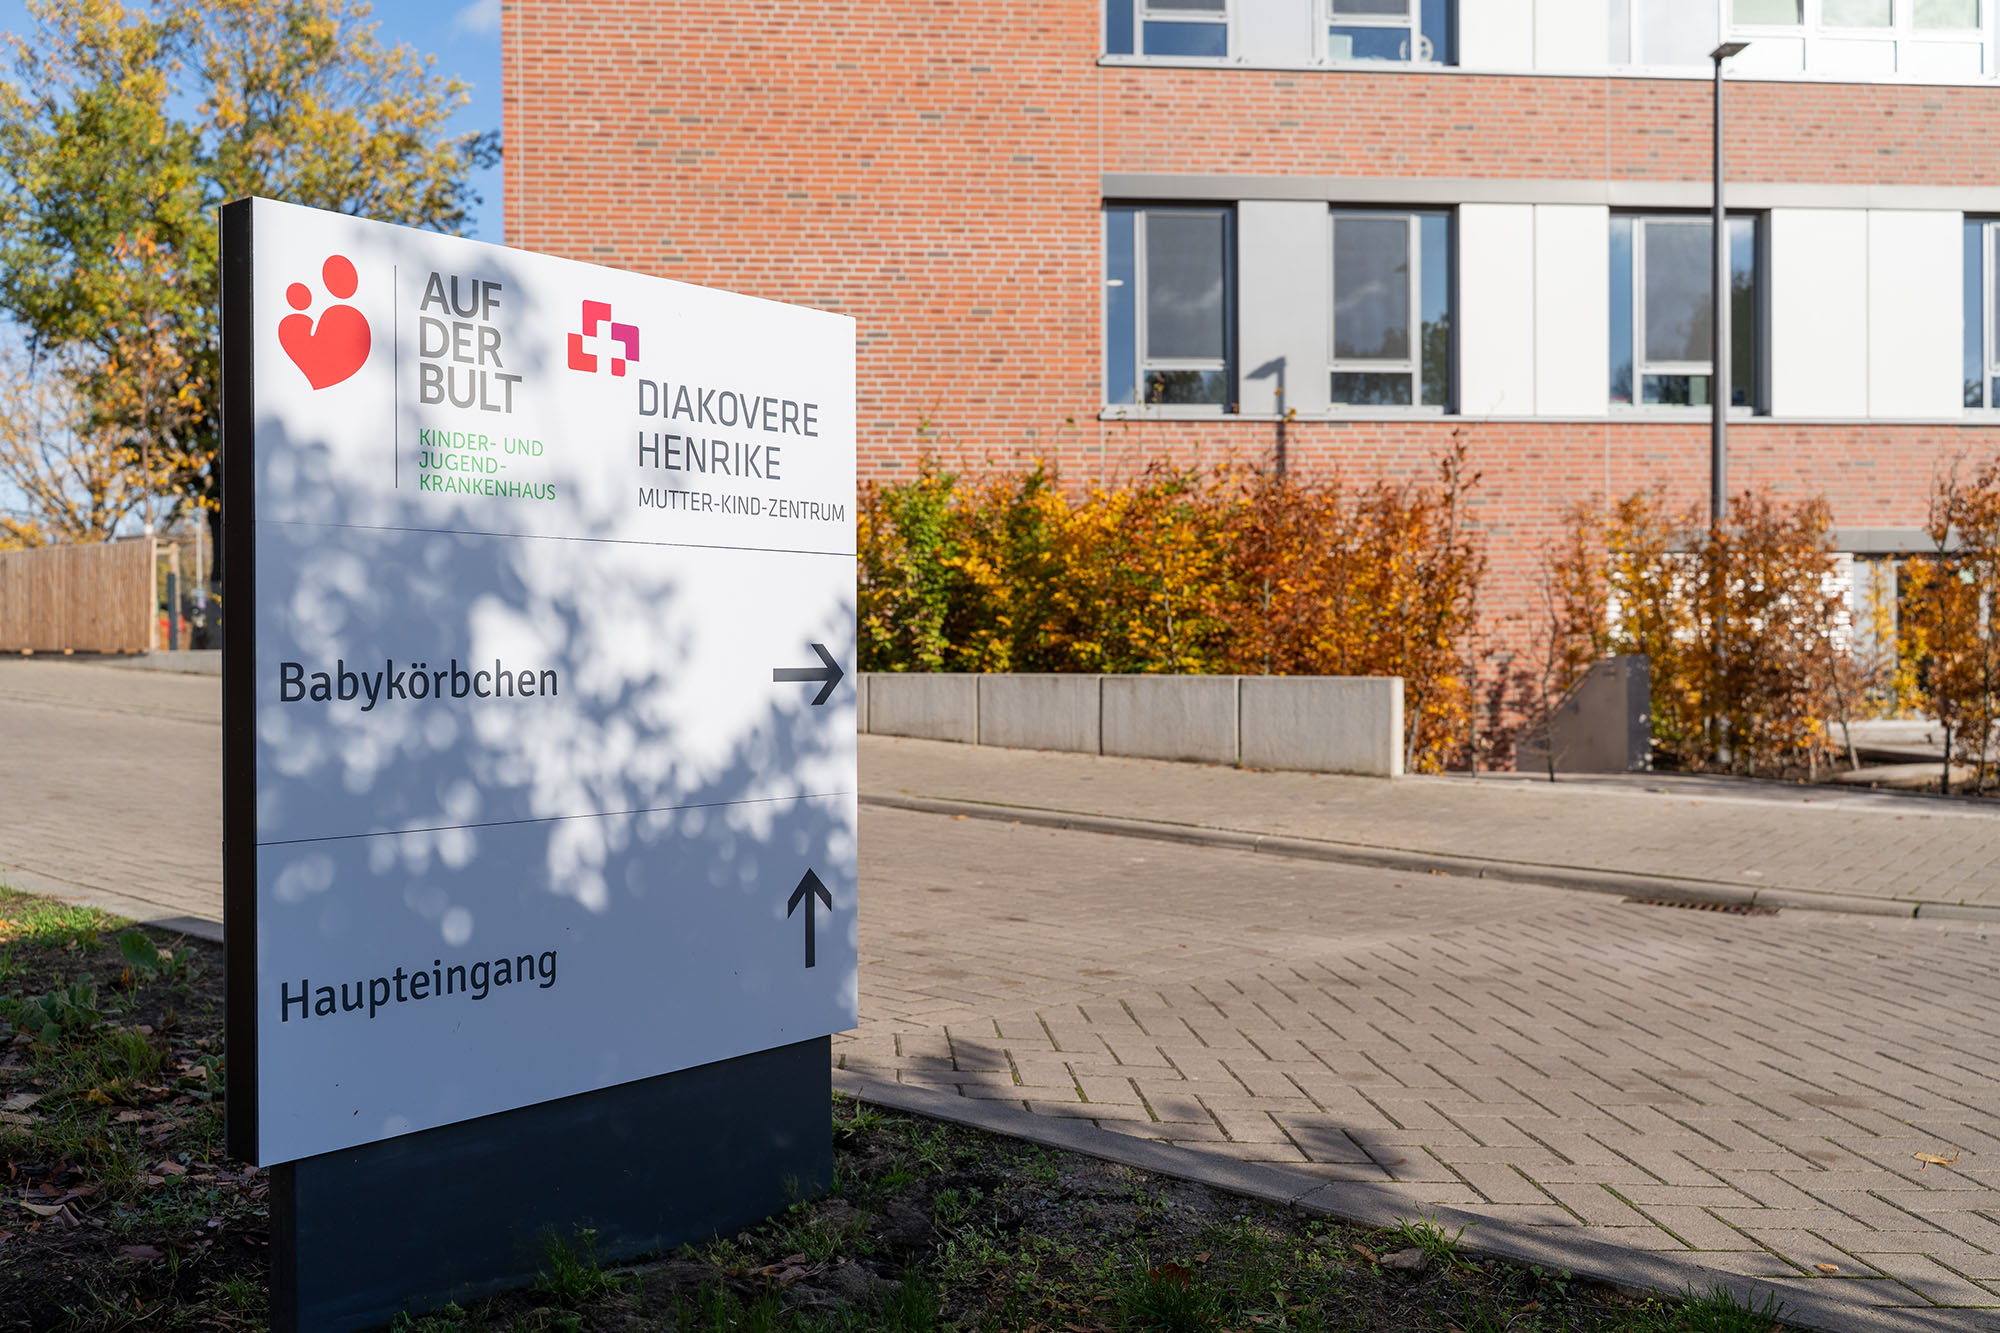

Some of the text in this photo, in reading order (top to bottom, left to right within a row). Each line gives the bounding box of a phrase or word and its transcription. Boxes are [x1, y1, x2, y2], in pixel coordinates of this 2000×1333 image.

[419, 271, 503, 322] AUF
[419, 315, 504, 369] DER
[419, 360, 523, 414] BULT
[638, 378, 819, 438] DIAKOVERE
[418, 451, 507, 474] JUGEND-
[419, 427, 544, 457] KINDER- UND
[638, 431, 781, 480] HENRIKE
[419, 473, 556, 500] KRANKENHAUS
[638, 487, 845, 522] MUTTER-KIND-ZENTRUM
[280, 658, 558, 712] Babykörbchen
[281, 950, 558, 1023] Haupteingang
